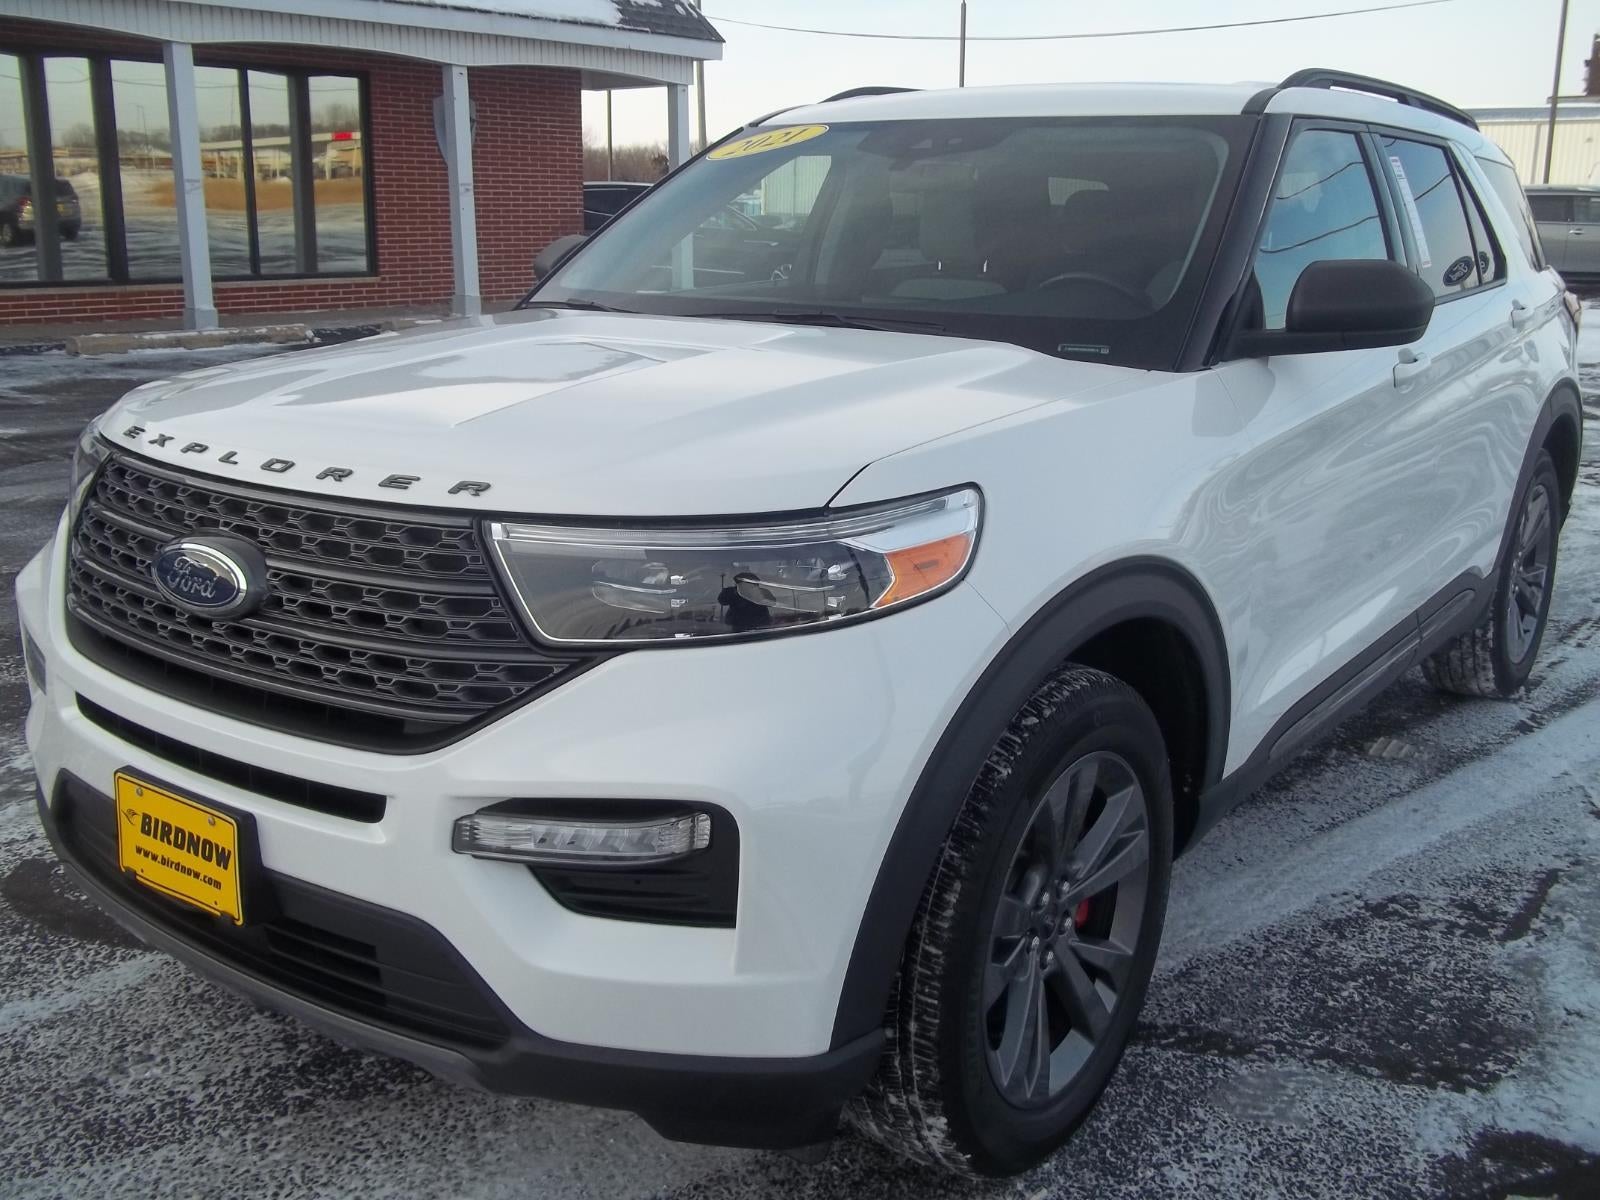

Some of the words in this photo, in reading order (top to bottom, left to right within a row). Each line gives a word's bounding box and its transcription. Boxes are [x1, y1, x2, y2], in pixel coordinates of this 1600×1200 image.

[123, 425, 491, 497] EXPLORER
[167, 556, 216, 598] Ford
[135, 845, 222, 890] www.birdnow.com
[141, 812, 232, 871] BIRDNOW
